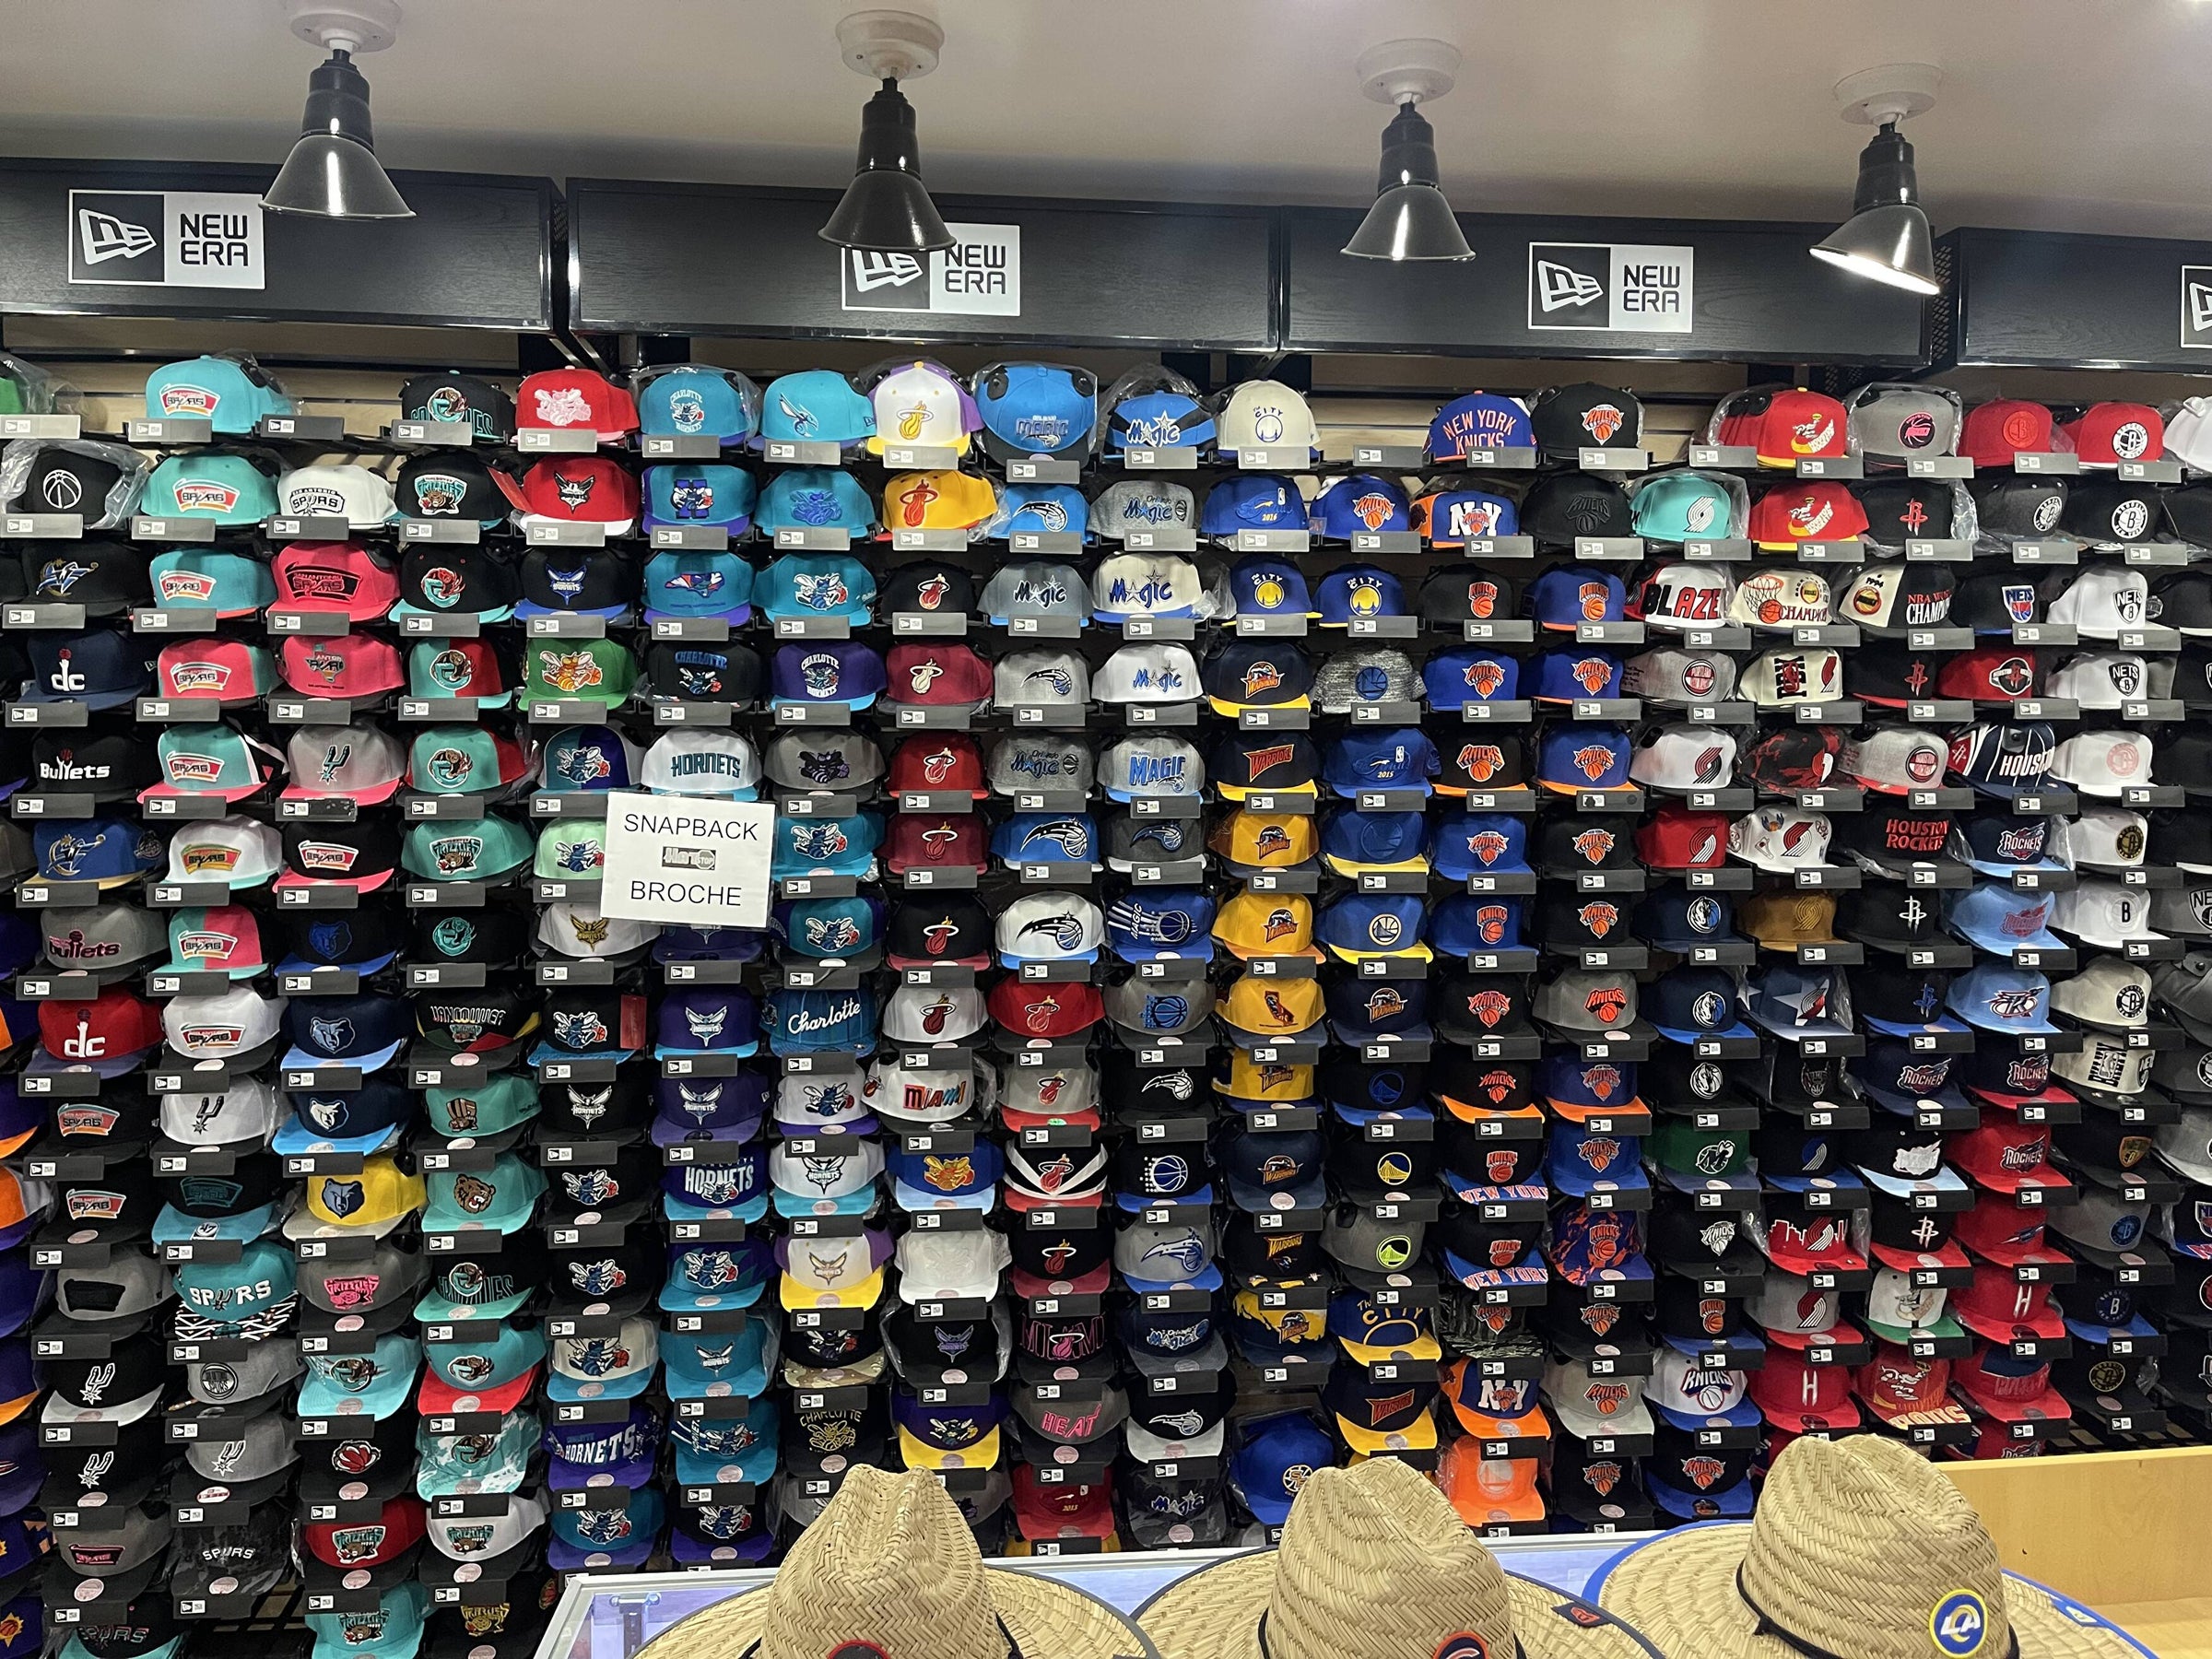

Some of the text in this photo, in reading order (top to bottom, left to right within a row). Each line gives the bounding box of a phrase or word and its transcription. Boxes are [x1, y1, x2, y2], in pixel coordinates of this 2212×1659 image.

[180, 214, 248, 239] NEW
[181, 241, 249, 266] ERA
[945, 245, 1006, 269] NEW
[946, 270, 1006, 294] ERA
[1623, 265, 1681, 288] NEW
[1623, 290, 1680, 313] ERA
[670, 390, 702, 403] CHARLOTTE
[1255, 406, 1283, 418] CITY
[1585, 410, 1622, 425] KNICKS
[1442, 409, 1516, 439] NEW YORK
[1456, 433, 1505, 454] KNICKS
[291, 495, 337, 509] SPURS
[1356, 498, 1392, 512] KNICKS
[1254, 574, 1282, 585] CITY
[1349, 576, 1382, 589] CITY
[1908, 594, 1931, 605] NBA
[2006, 589, 2032, 602] NETS
[2117, 591, 2141, 605] NETS
[676, 653, 727, 670] CHARLOTTE
[801, 654, 839, 670] CHARLOTTE
[52, 660, 85, 690] dc
[1466, 665, 1503, 679] KNICKS
[2112, 666, 2137, 679] NETS
[1252, 748, 1292, 771] WARRIORS
[1459, 747, 1503, 765] KNICKS
[1577, 751, 1613, 766] KNICKS
[40, 755, 109, 780] Bullets
[671, 752, 740, 778] HORNETS
[624, 815, 759, 840] SNAPBACK
[1887, 819, 1947, 836] HOUSTON
[1471, 836, 1508, 849] KNICKS
[1577, 834, 1612, 848] KNICKS
[1888, 835, 1945, 852] ROCKETS
[2004, 835, 2041, 851] ROCKETS
[630, 881, 741, 905] BROCHE
[1131, 903, 1143, 939] MAGIC
[1478, 909, 1506, 921] KNICKS
[1582, 906, 1616, 920] KNICKS
[50, 938, 120, 959] bullets
[1472, 994, 1509, 1011] KNICKS
[1586, 989, 1624, 1006] KNICKS
[430, 1006, 506, 1025] VANCOUVER
[788, 999, 860, 1034] Charlotte
[65, 1022, 104, 1057] dc
[1905, 1069, 1943, 1087] ROCKETS
[2014, 1065, 2047, 1080] ROCKETS
[1480, 1075, 1515, 1088] KNICKS
[904, 1082, 965, 1110] MIAMI
[1582, 1142, 1618, 1155] KNICKS
[2006, 1151, 2041, 1164] ROCKETS
[686, 1166, 753, 1194] HORNETS
[1459, 1186, 1500, 1204] NEW
[1590, 1225, 1619, 1240] KNICKS
[1268, 1235, 1301, 1255] WARRIORS
[1465, 1269, 1502, 1289] NEW
[190, 1279, 270, 1311] SPURS
[2015, 1286, 2031, 1318] H
[1583, 1308, 1618, 1321] KNICKS
[1683, 1370, 1732, 1390] KNICKS
[1804, 1370, 1817, 1406] H
[1586, 1384, 1628, 1401] KNICKS
[1373, 1393, 1413, 1422] WARRIORS
[1041, 1405, 1100, 1437] HEAT
[565, 1425, 636, 1464] HORNETS
[1587, 1464, 1620, 1478] KNICKS
[1685, 1460, 1723, 1475] KNICKS
[203, 1547, 254, 1561] SPURS
